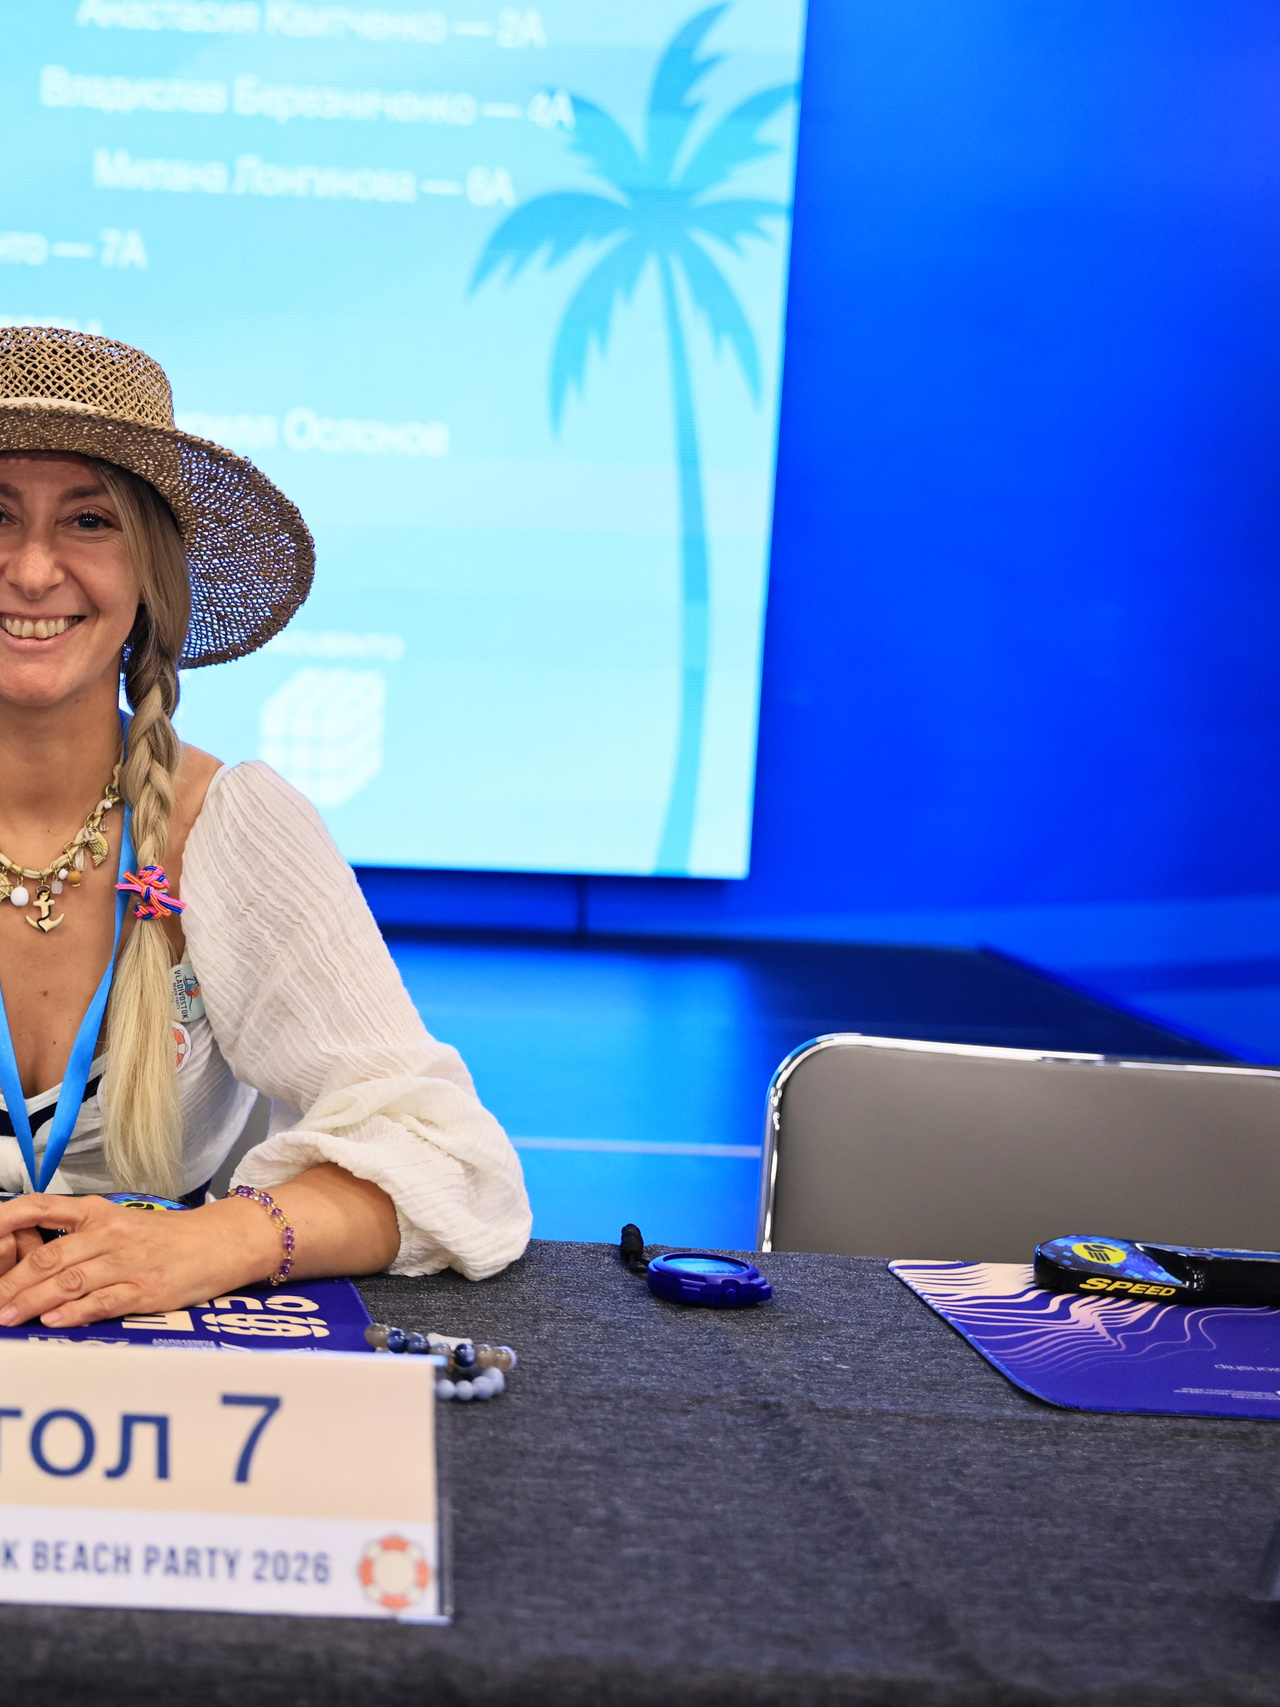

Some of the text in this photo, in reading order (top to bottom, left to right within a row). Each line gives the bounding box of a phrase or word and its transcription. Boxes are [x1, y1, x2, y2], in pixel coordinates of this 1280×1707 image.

[174, 969, 189, 1020] VLADIVOSTOK
[1079, 1277, 1176, 1297] SPEED
[220, 1394, 283, 1485] 7
[32, 1539, 132, 1576] BEACH
[142, 1544, 241, 1581] PARTY
[252, 1549, 332, 1584] 2026
